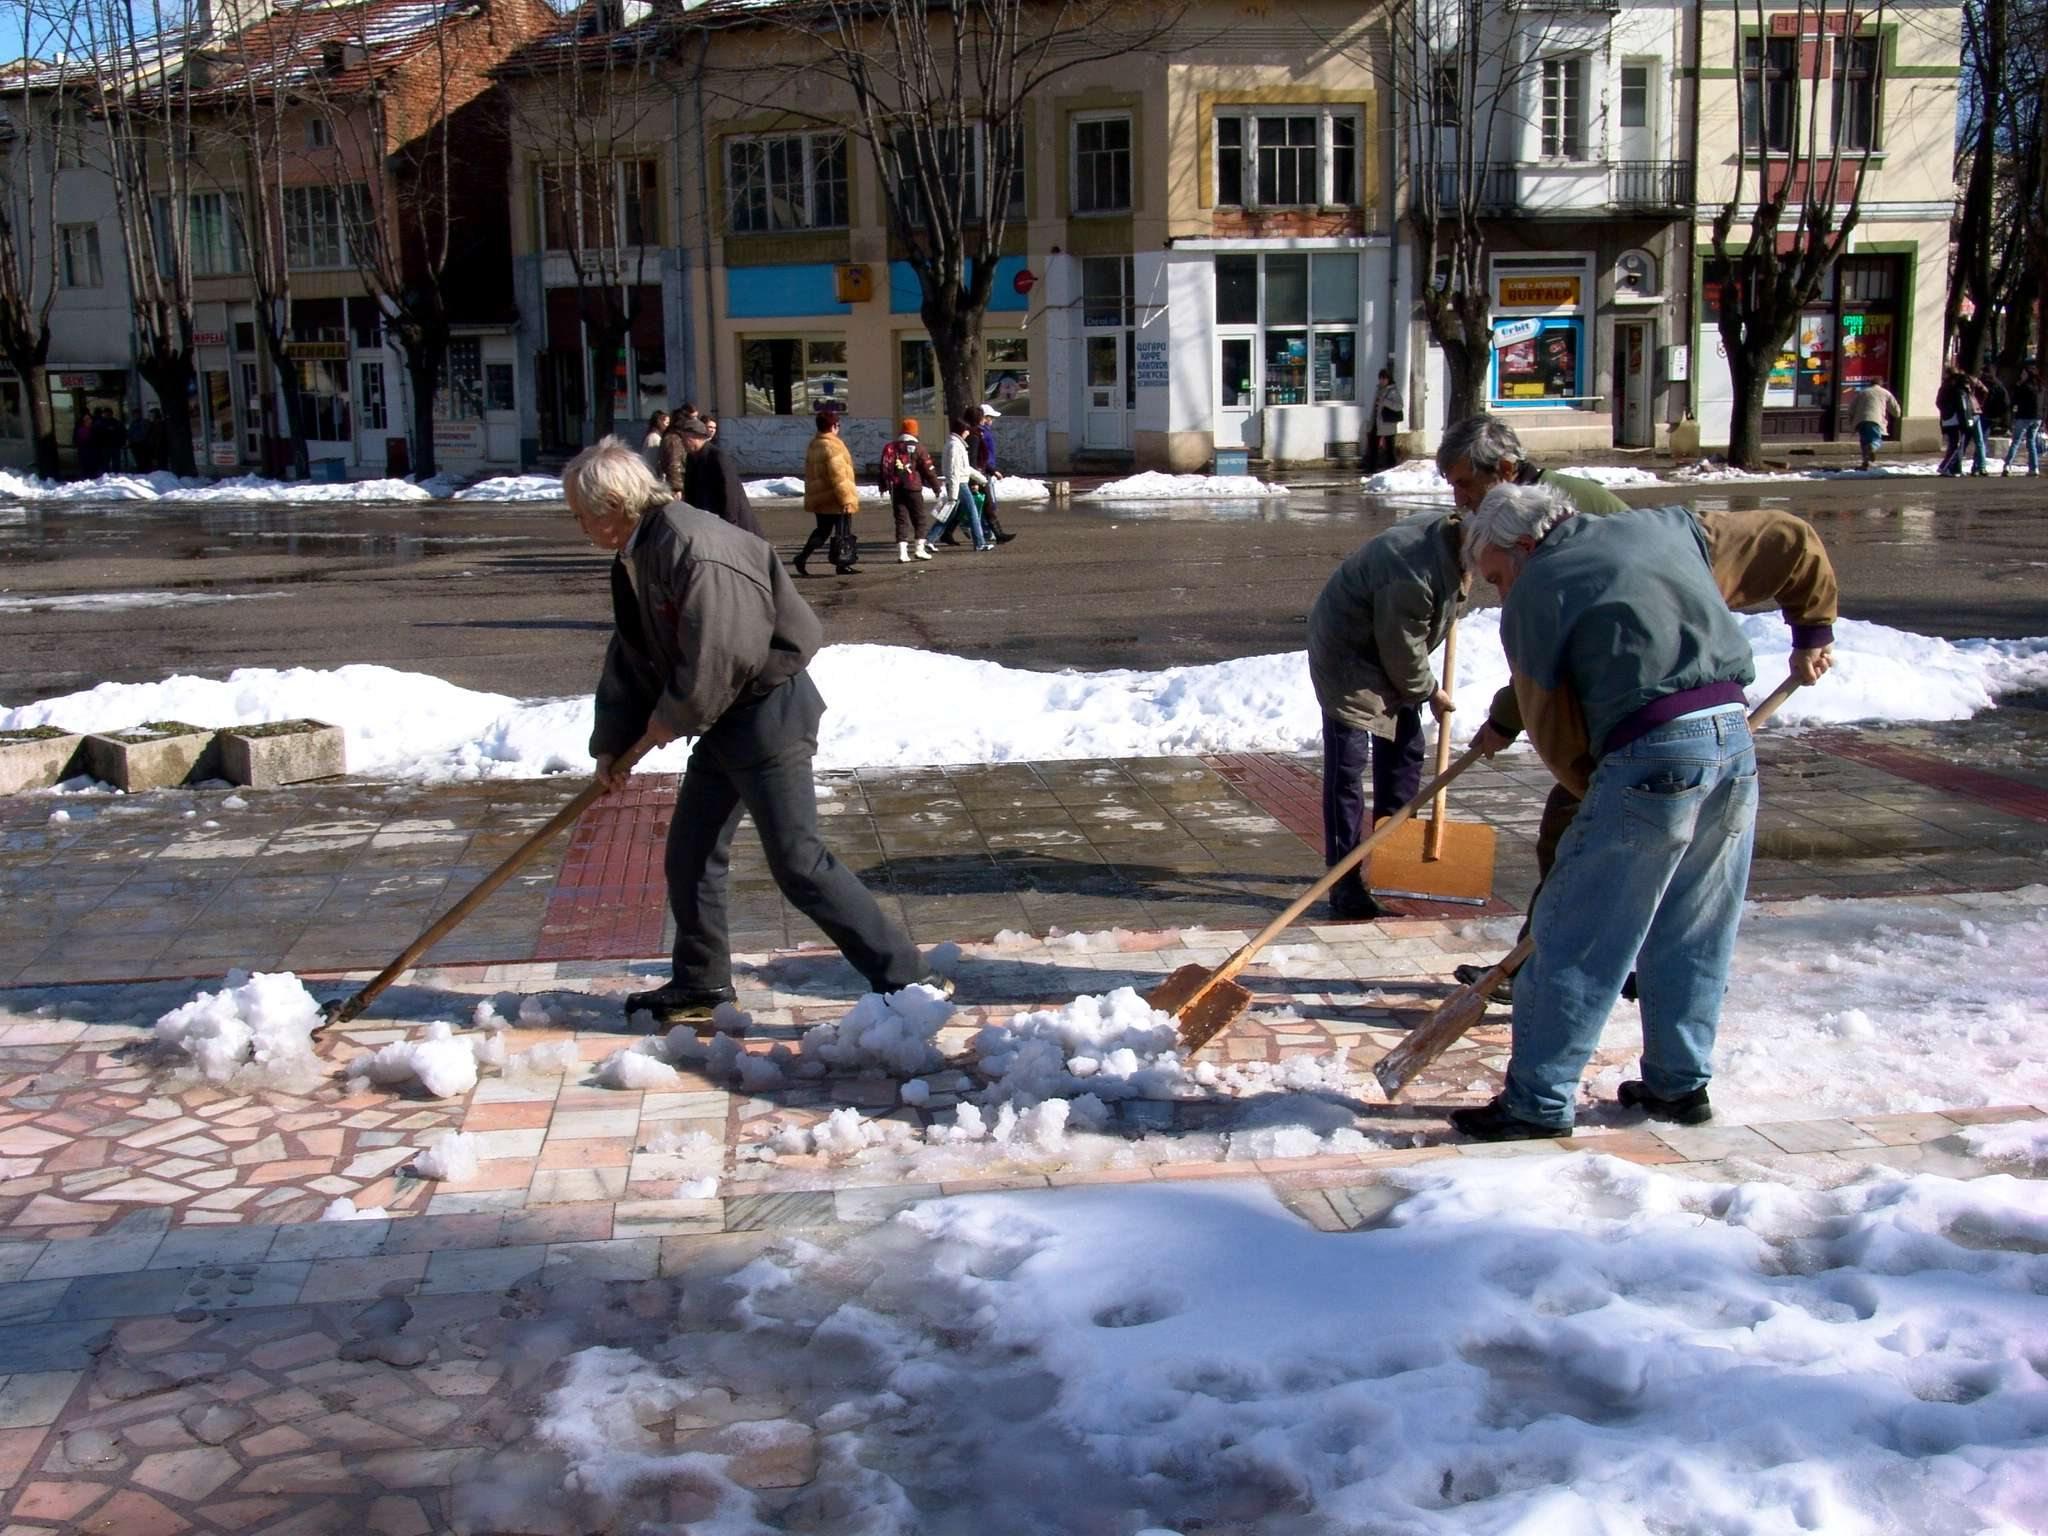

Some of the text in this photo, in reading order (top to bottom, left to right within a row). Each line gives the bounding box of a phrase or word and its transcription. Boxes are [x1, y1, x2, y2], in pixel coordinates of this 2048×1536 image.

[1508, 288, 1573, 301] BUFFALO
[1501, 322, 1531, 336] Orbit
[1141, 352, 1161, 360] КАФЕ
